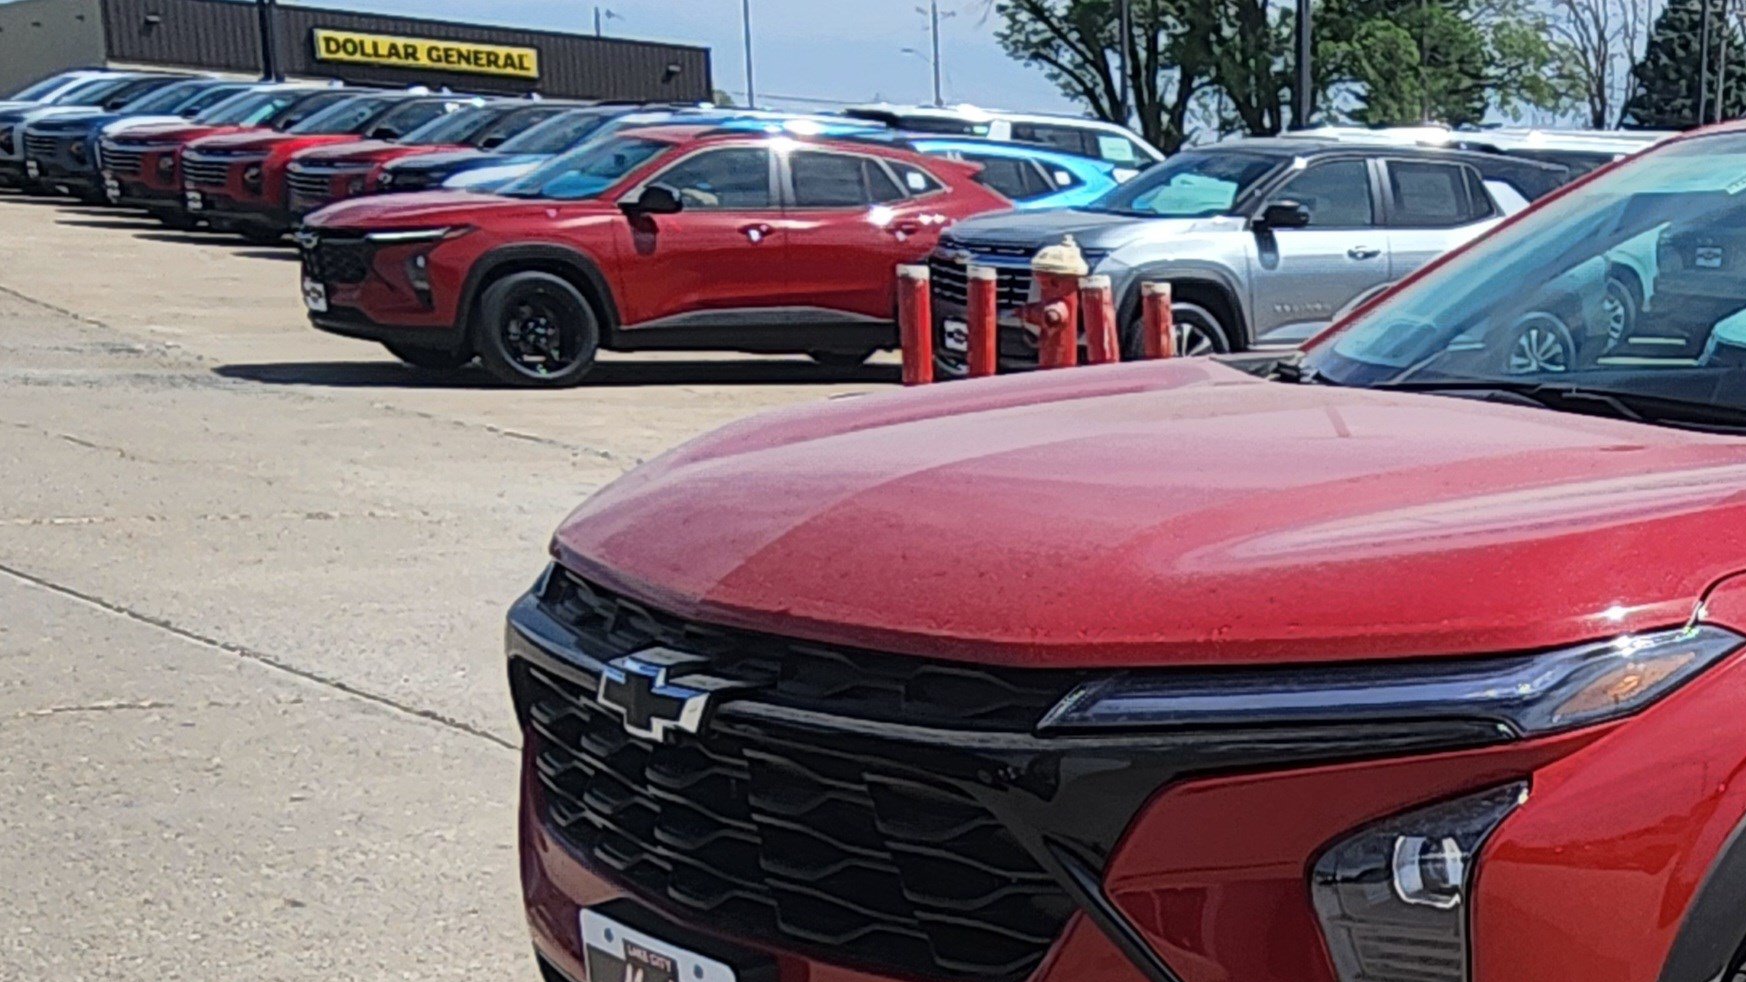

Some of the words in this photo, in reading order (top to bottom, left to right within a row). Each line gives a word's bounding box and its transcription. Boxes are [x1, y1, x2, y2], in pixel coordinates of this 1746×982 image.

[323, 36, 420, 62] DOLLAR
[426, 45, 531, 71] GENERAL
[650, 956, 672, 973] CITY
